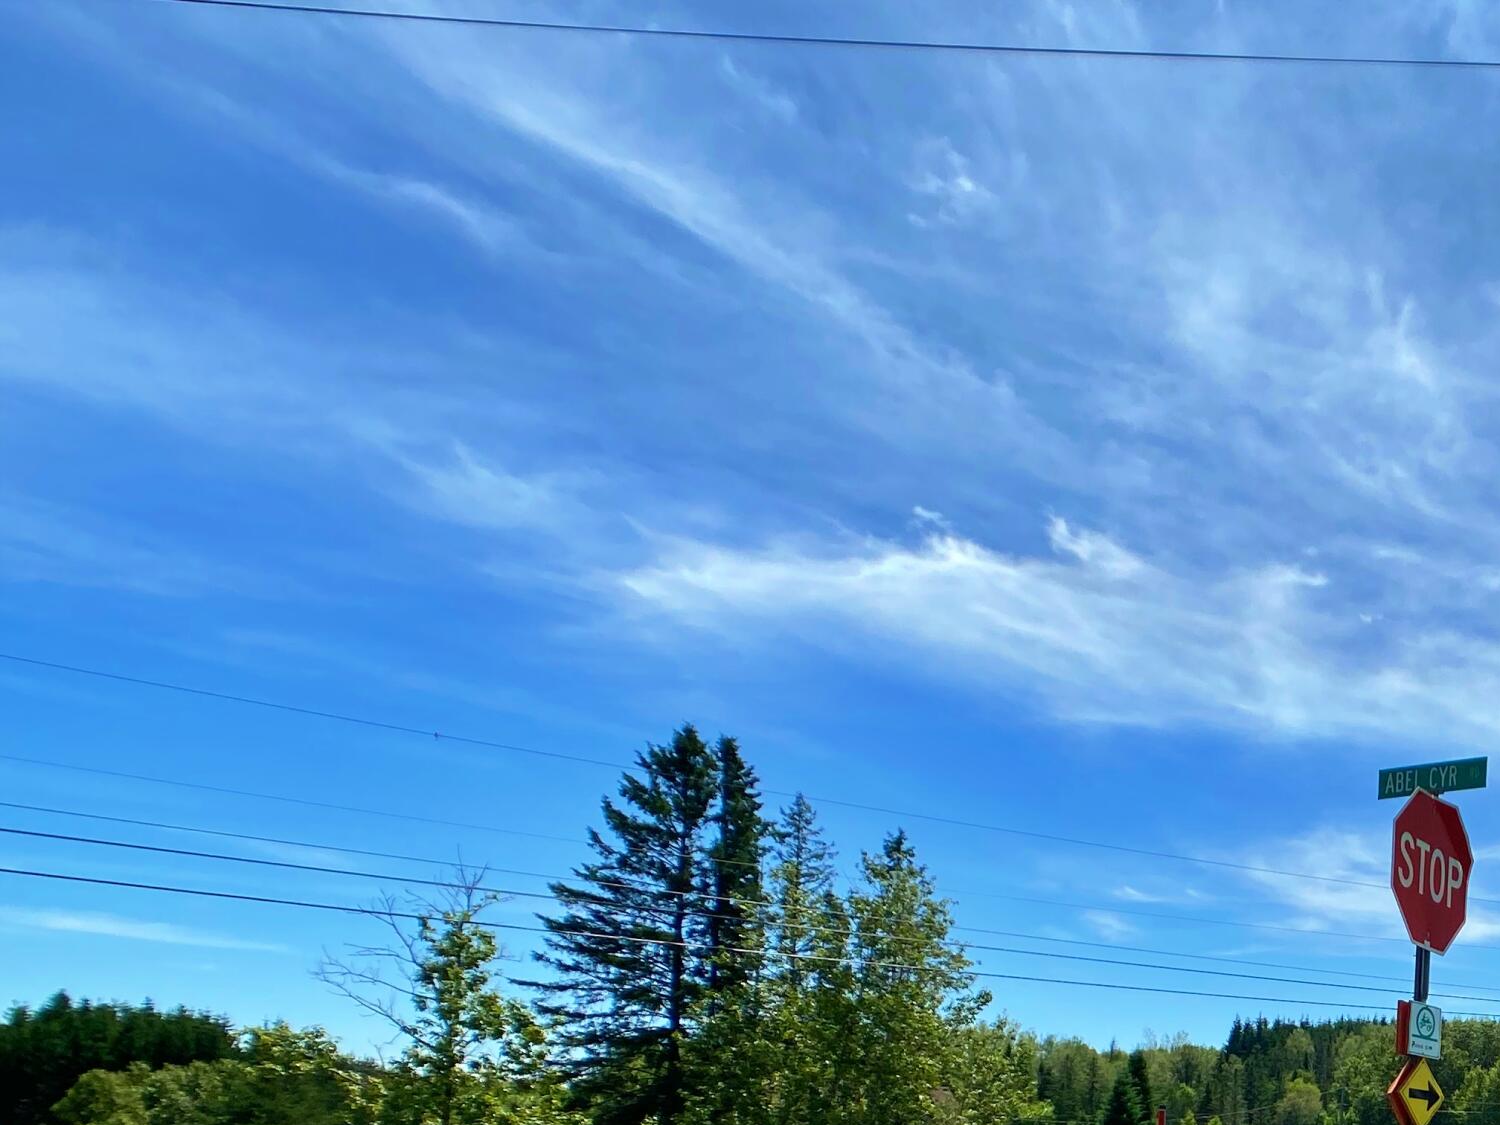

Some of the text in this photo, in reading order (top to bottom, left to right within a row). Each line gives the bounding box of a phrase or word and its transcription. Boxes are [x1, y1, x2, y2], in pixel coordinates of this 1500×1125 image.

[1385, 770, 1418, 794] ABEL
[1429, 765, 1458, 789] CYR
[1398, 831, 1464, 908] STOP
